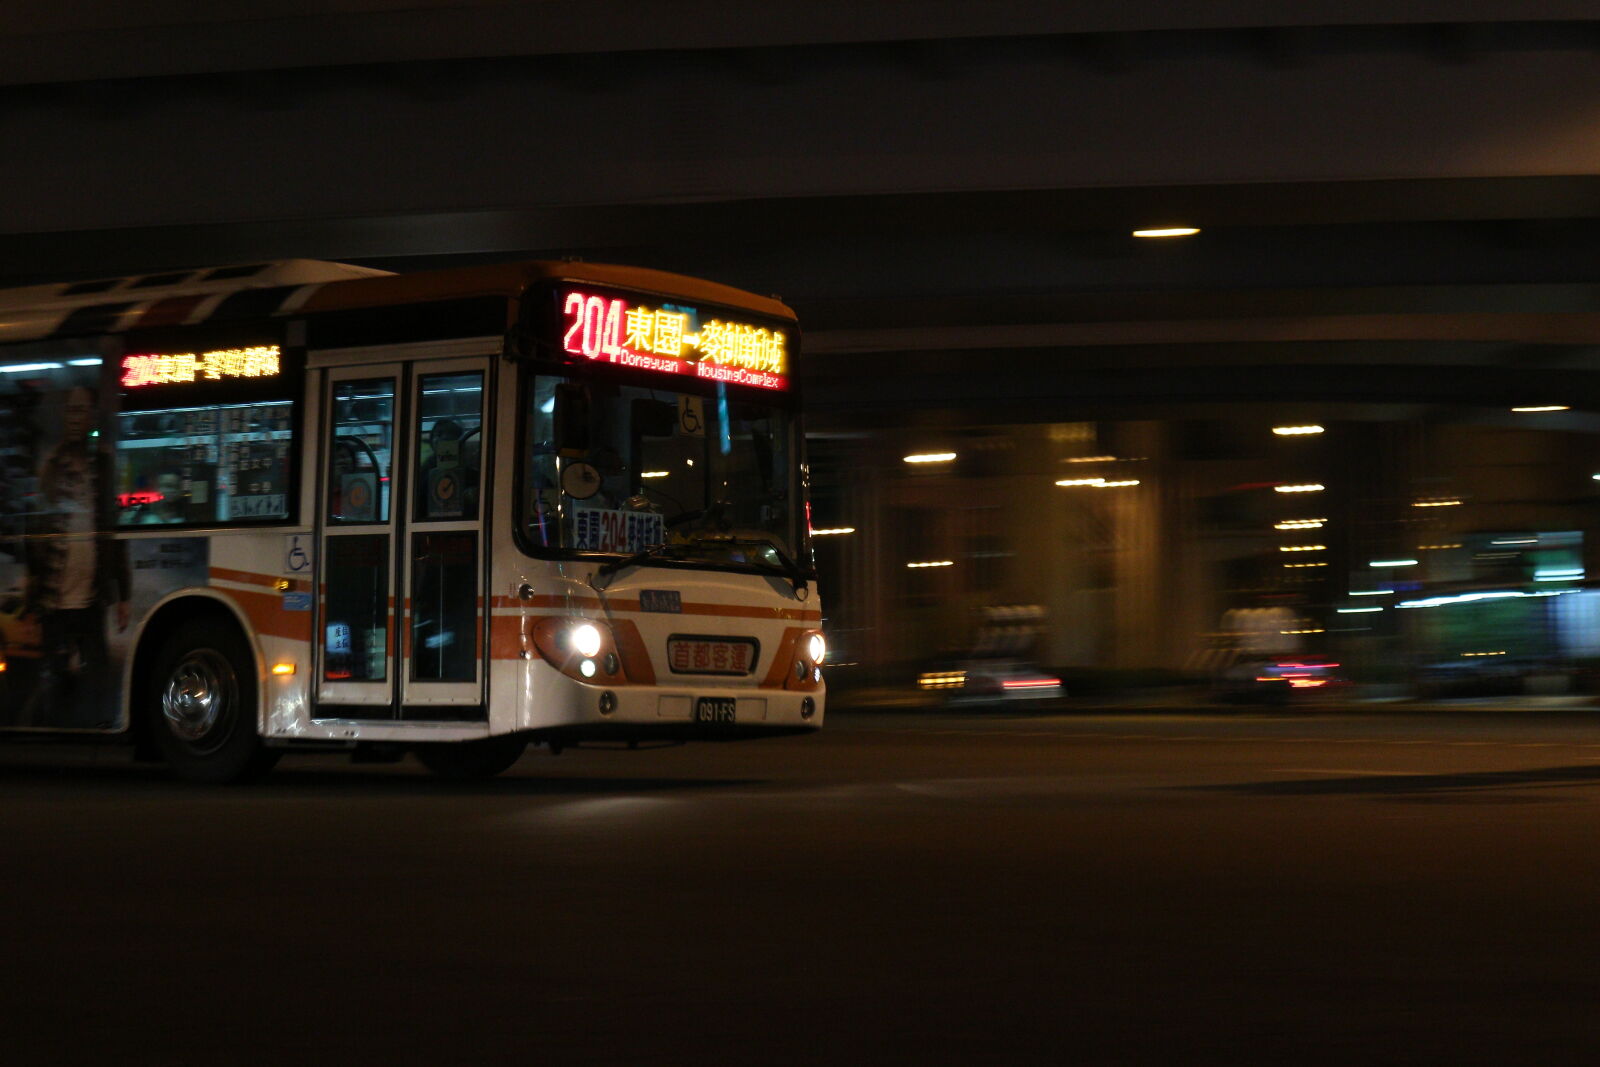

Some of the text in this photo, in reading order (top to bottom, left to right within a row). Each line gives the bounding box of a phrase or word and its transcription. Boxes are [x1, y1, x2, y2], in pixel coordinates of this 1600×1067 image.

[563, 291, 622, 363] 204
[622, 306, 685, 357] 東園
[621, 349, 679, 373] Dongyuan
[602, 511, 626, 553] 204
[673, 642, 748, 671] 首都客運
